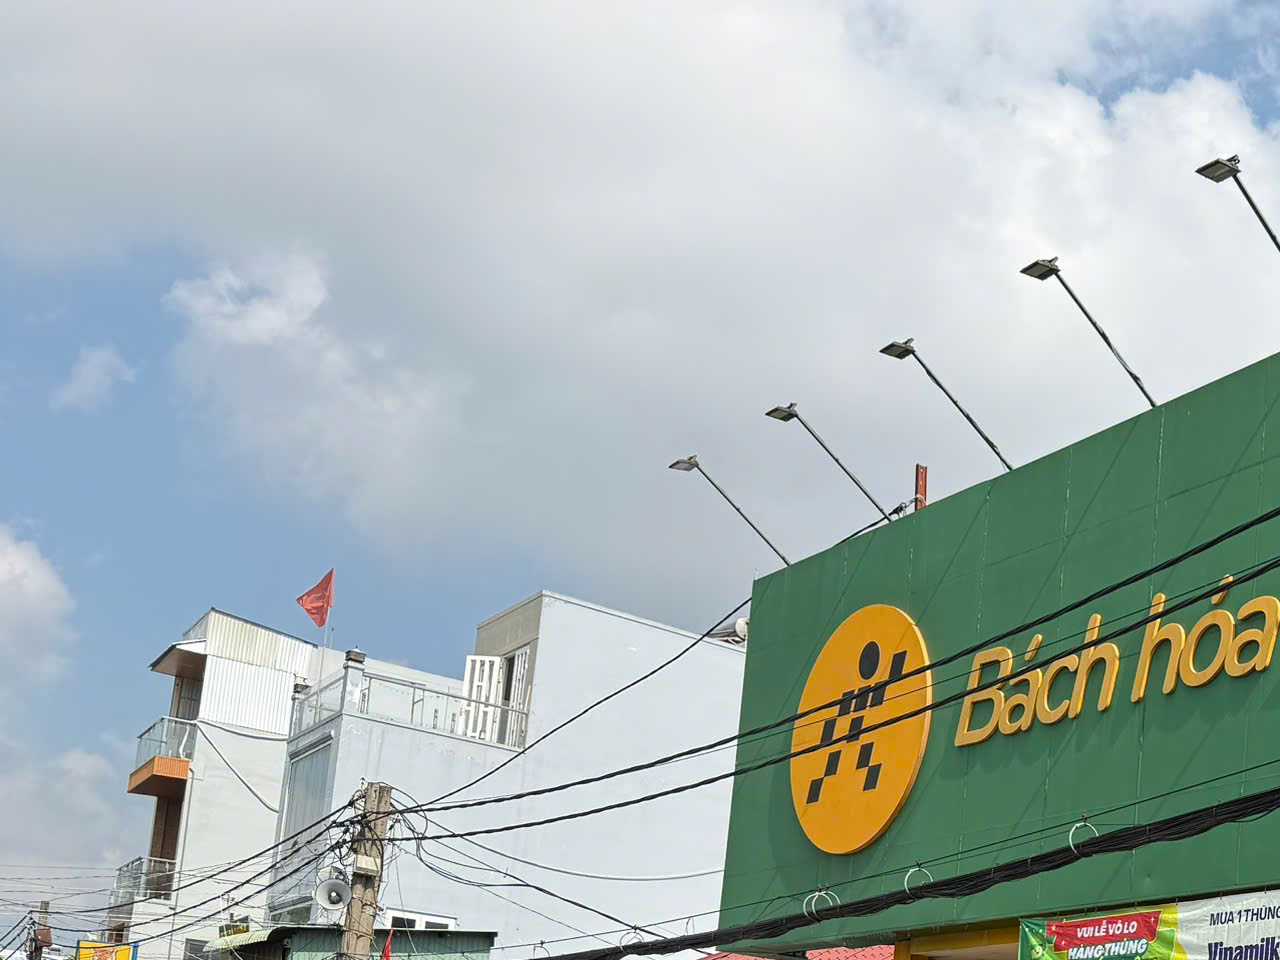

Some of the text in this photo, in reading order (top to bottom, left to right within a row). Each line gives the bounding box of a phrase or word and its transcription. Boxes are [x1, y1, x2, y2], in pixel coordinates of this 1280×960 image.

[953, 613, 1121, 748] Bách
[1131, 575, 1280, 704] hóa
[1209, 911, 1235, 927] MUA
[1237, 909, 1242, 923] 1
[1076, 920, 1138, 939] VUI LỄ VÔ LO
[1067, 938, 1148, 960] HÀNG THÙNG
